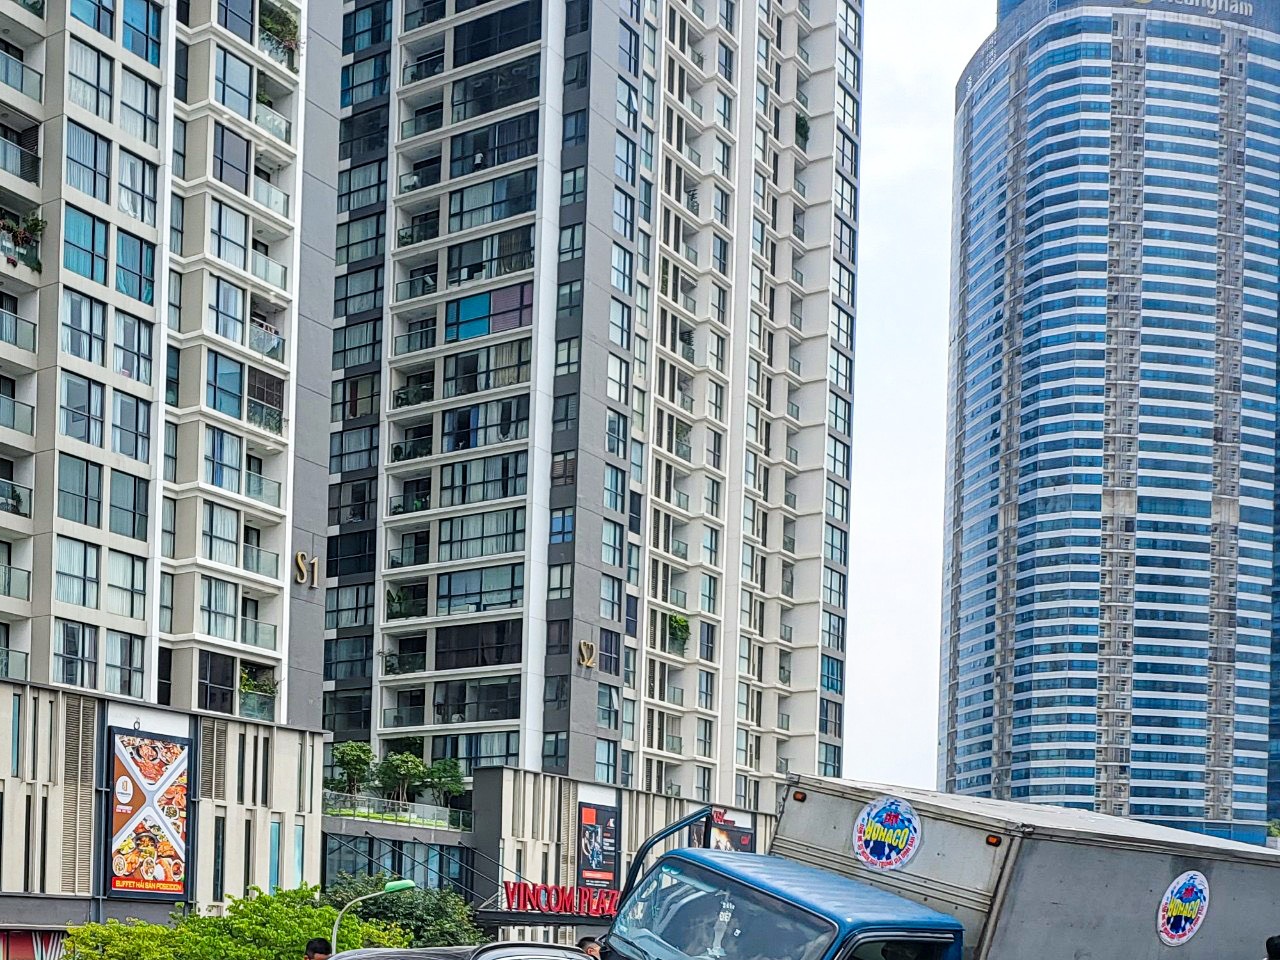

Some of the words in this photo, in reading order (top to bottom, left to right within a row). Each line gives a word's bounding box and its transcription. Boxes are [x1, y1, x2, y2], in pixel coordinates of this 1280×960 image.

[295, 551, 319, 589] S1
[578, 639, 596, 668] S2
[115, 880, 136, 888] BUFFET
[503, 881, 575, 915] VINCOM
[578, 886, 620, 918] PLAZ
